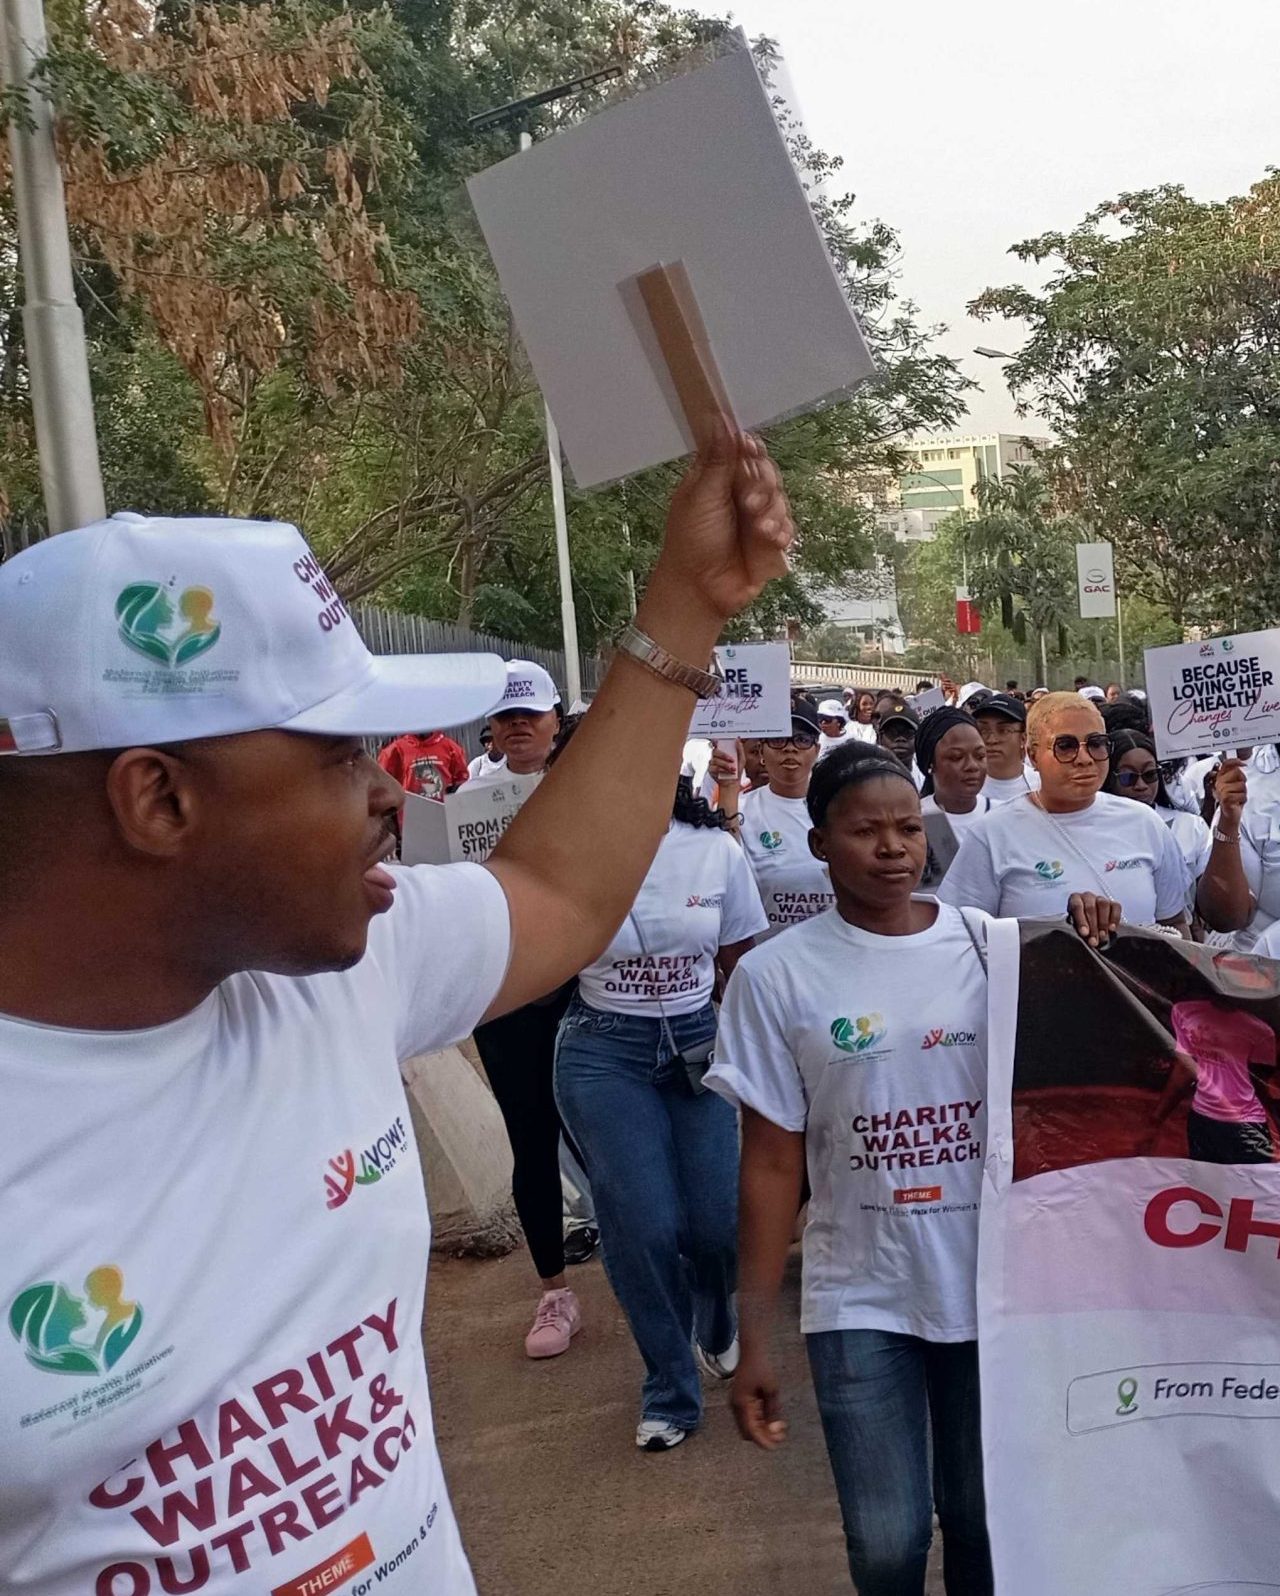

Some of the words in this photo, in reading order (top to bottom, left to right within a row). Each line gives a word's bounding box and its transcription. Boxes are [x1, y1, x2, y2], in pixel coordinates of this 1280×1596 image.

[1084, 585, 1111, 593] GAC
[724, 668, 748, 683] RE
[1182, 657, 1261, 683] BECAUSE
[726, 683, 763, 698] HER
[1173, 679, 1236, 701] LOVING
[1239, 671, 1273, 690] HER
[1192, 689, 1258, 714] HEALTH
[1167, 700, 1232, 735] Changes
[458, 818, 498, 839] FROM
[773, 893, 835, 903] CHARIT
[779, 904, 828, 914] WALK
[612, 953, 703, 969] CHARITY
[620, 967, 693, 982] WALK&
[605, 978, 699, 996] OUTREACH
[852, 1100, 983, 1134] CHARITY
[862, 1122, 972, 1152] WALK&
[850, 1142, 981, 1171] OUTREACH
[1154, 1378, 1213, 1400] From
[88, 1297, 399, 1509] CHARITY
[130, 1372, 403, 1547] WALK&
[297, 1553, 355, 1596] THEME
